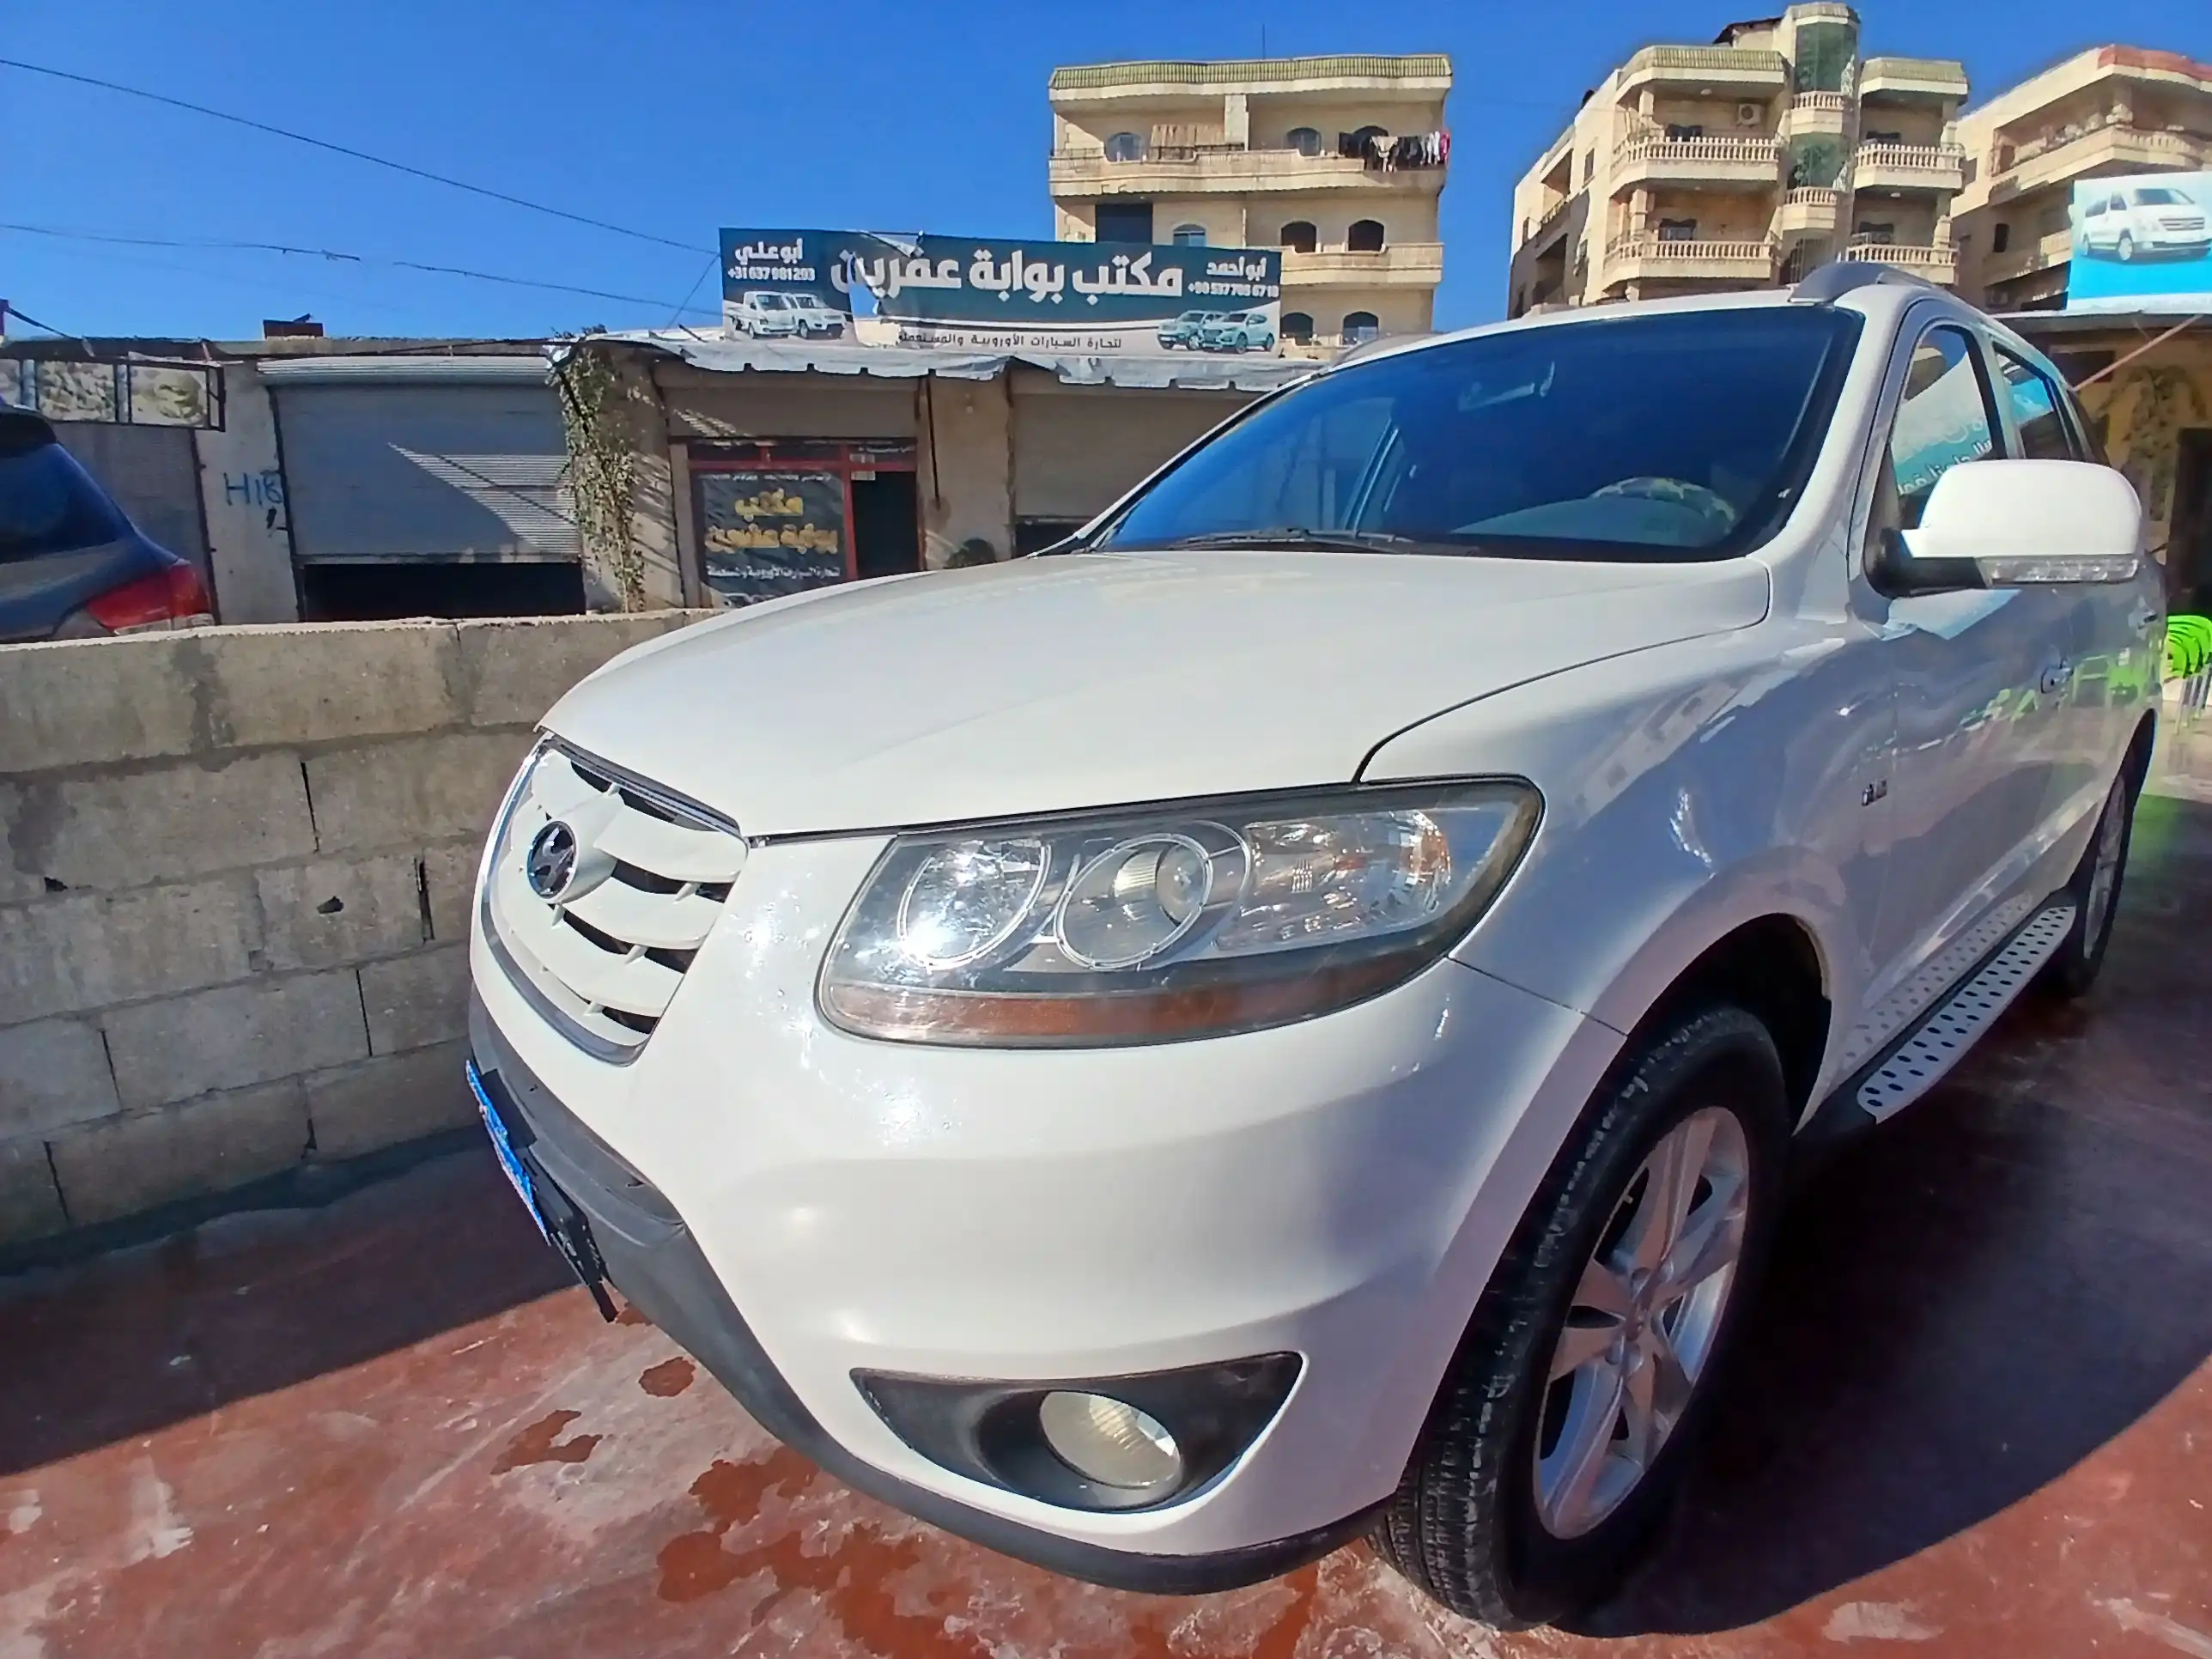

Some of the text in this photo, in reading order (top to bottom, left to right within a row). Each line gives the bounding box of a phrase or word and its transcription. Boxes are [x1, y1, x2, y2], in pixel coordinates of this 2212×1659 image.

[735, 241, 779, 265] علي
[969, 249, 1065, 304] بوابة
[1073, 251, 1182, 306] مكتب
[1030, 337, 1080, 349] السيارات
[1087, 338, 1121, 349] لتجارة
